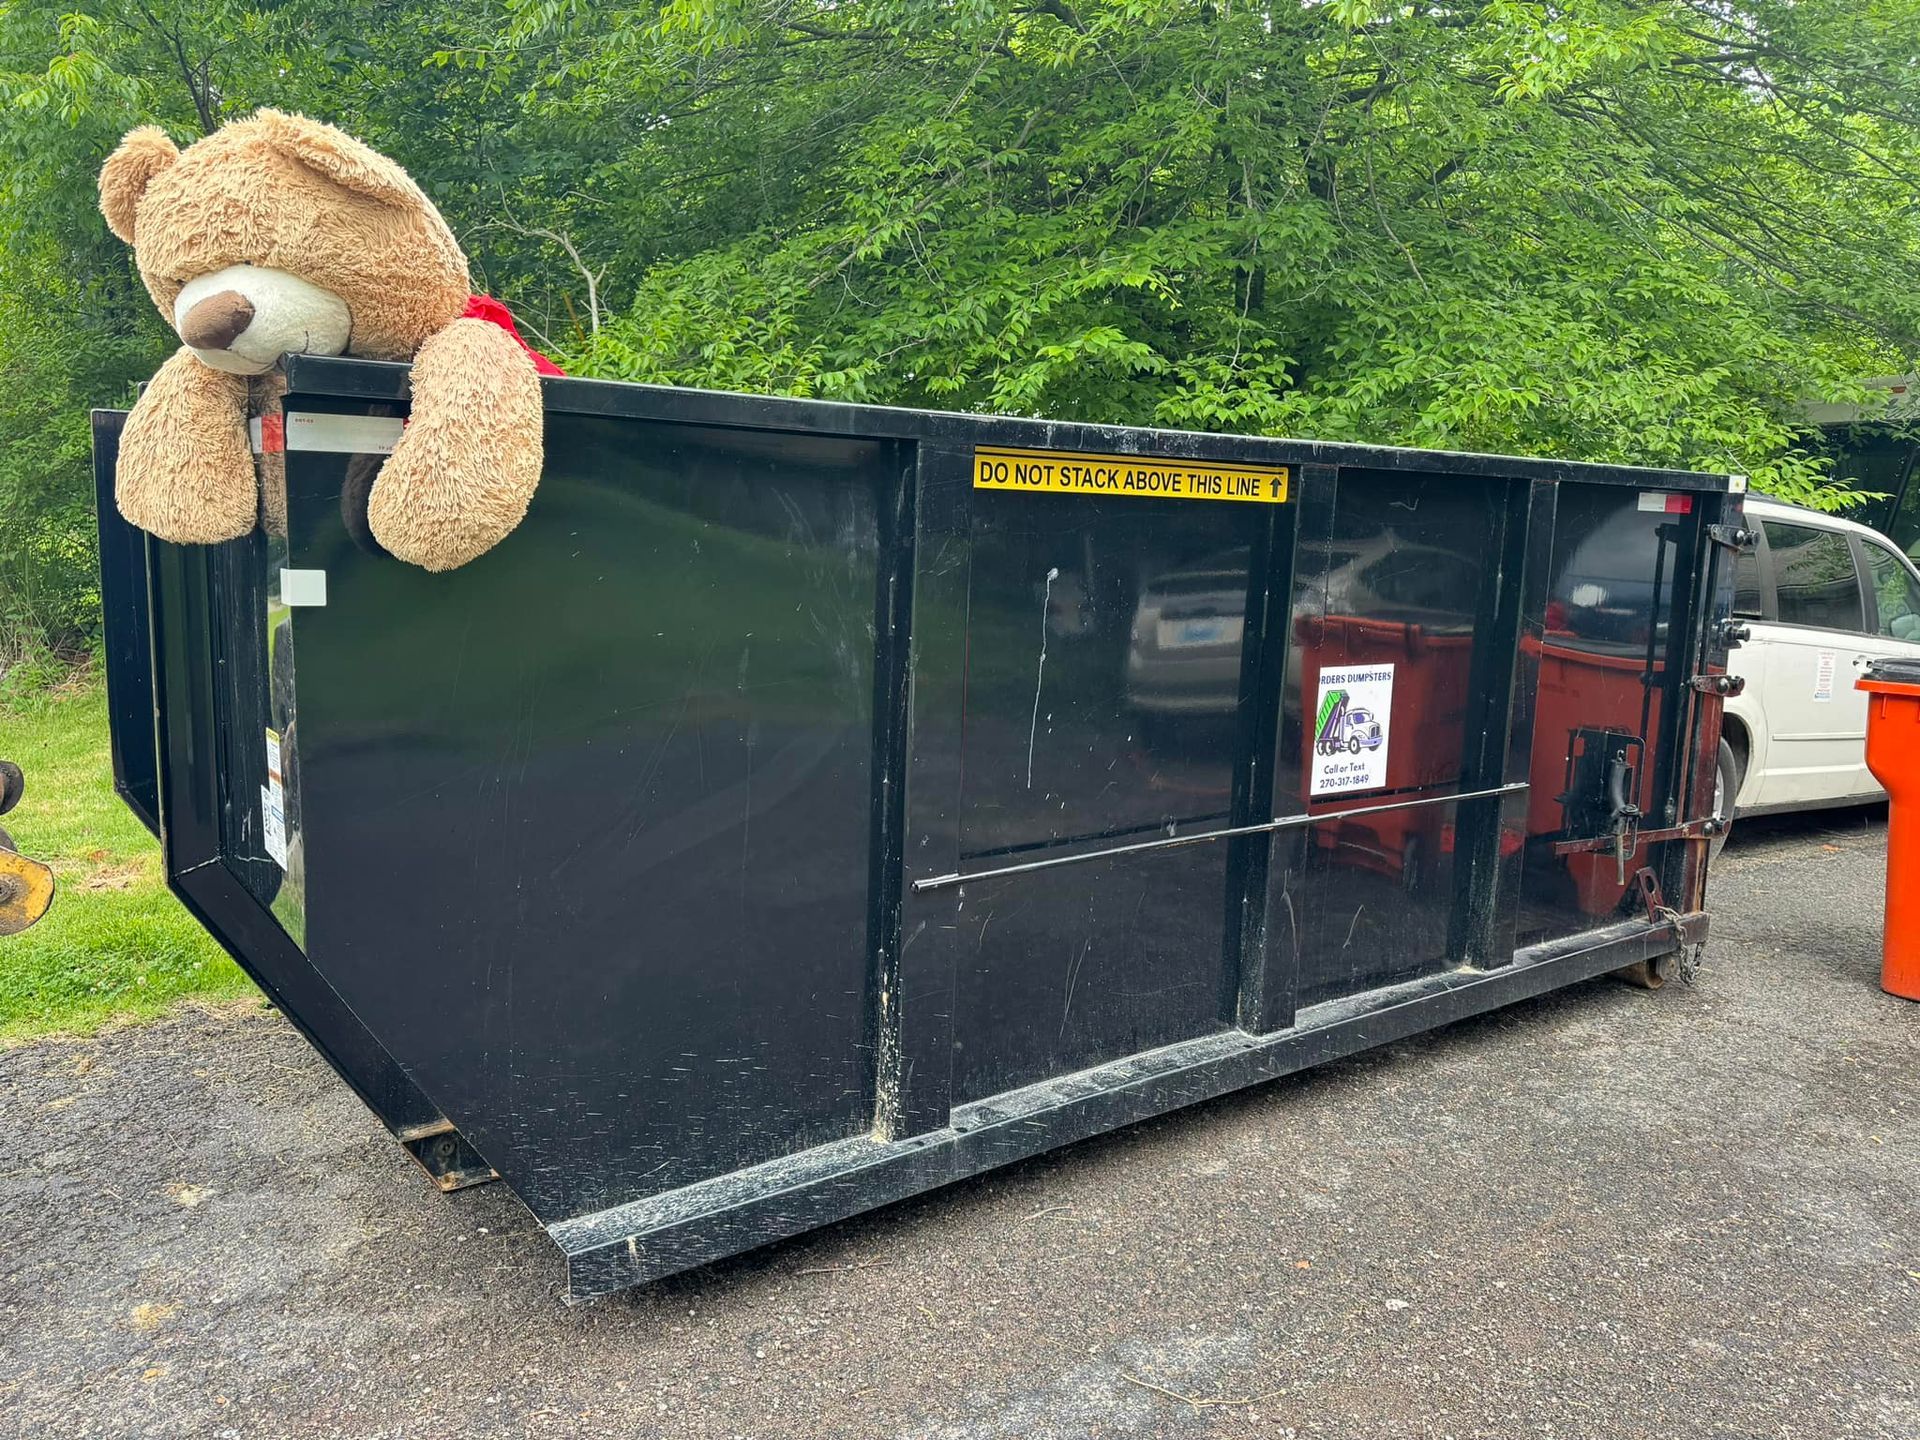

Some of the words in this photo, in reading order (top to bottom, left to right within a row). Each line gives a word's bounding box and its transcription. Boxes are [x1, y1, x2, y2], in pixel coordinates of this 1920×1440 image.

[980, 461, 1009, 483] DO
[1015, 463, 1054, 486] NOT
[1060, 466, 1120, 489] STACK
[1123, 470, 1182, 492] ABOVE
[1188, 474, 1222, 494] THIS
[1227, 477, 1261, 496] LINE
[1319, 674, 1346, 685] RDERS
[1347, 671, 1392, 683] DUMPSTERS
[1324, 764, 1339, 775] Call
[1350, 762, 1365, 772] Text
[1320, 774, 1369, 789] 270-317-1849
